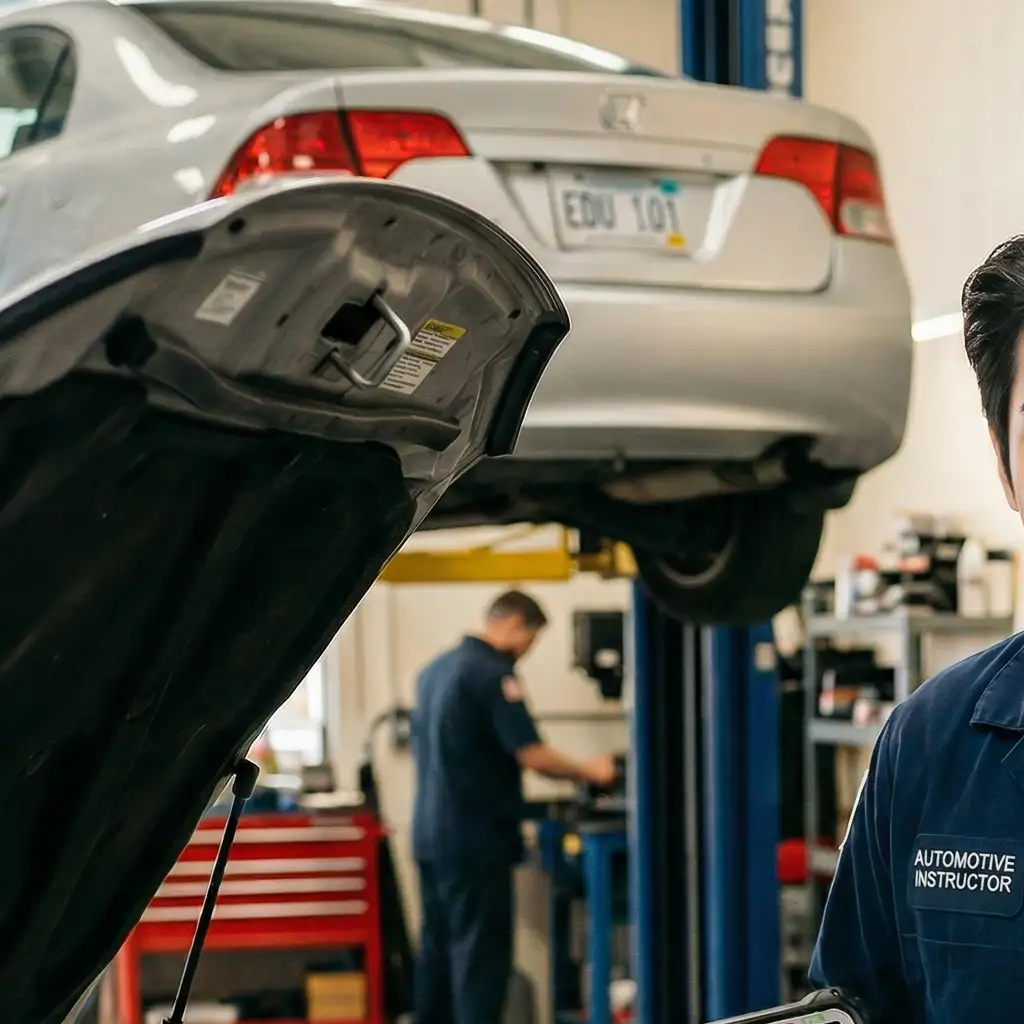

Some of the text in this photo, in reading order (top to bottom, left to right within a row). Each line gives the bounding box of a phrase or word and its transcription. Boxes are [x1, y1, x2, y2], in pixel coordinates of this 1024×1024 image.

[562, 189, 679, 232] EDU 101
[914, 849, 1016, 872] AUTOMOTIVE
[914, 870, 1012, 893] INSTRUCTOR
